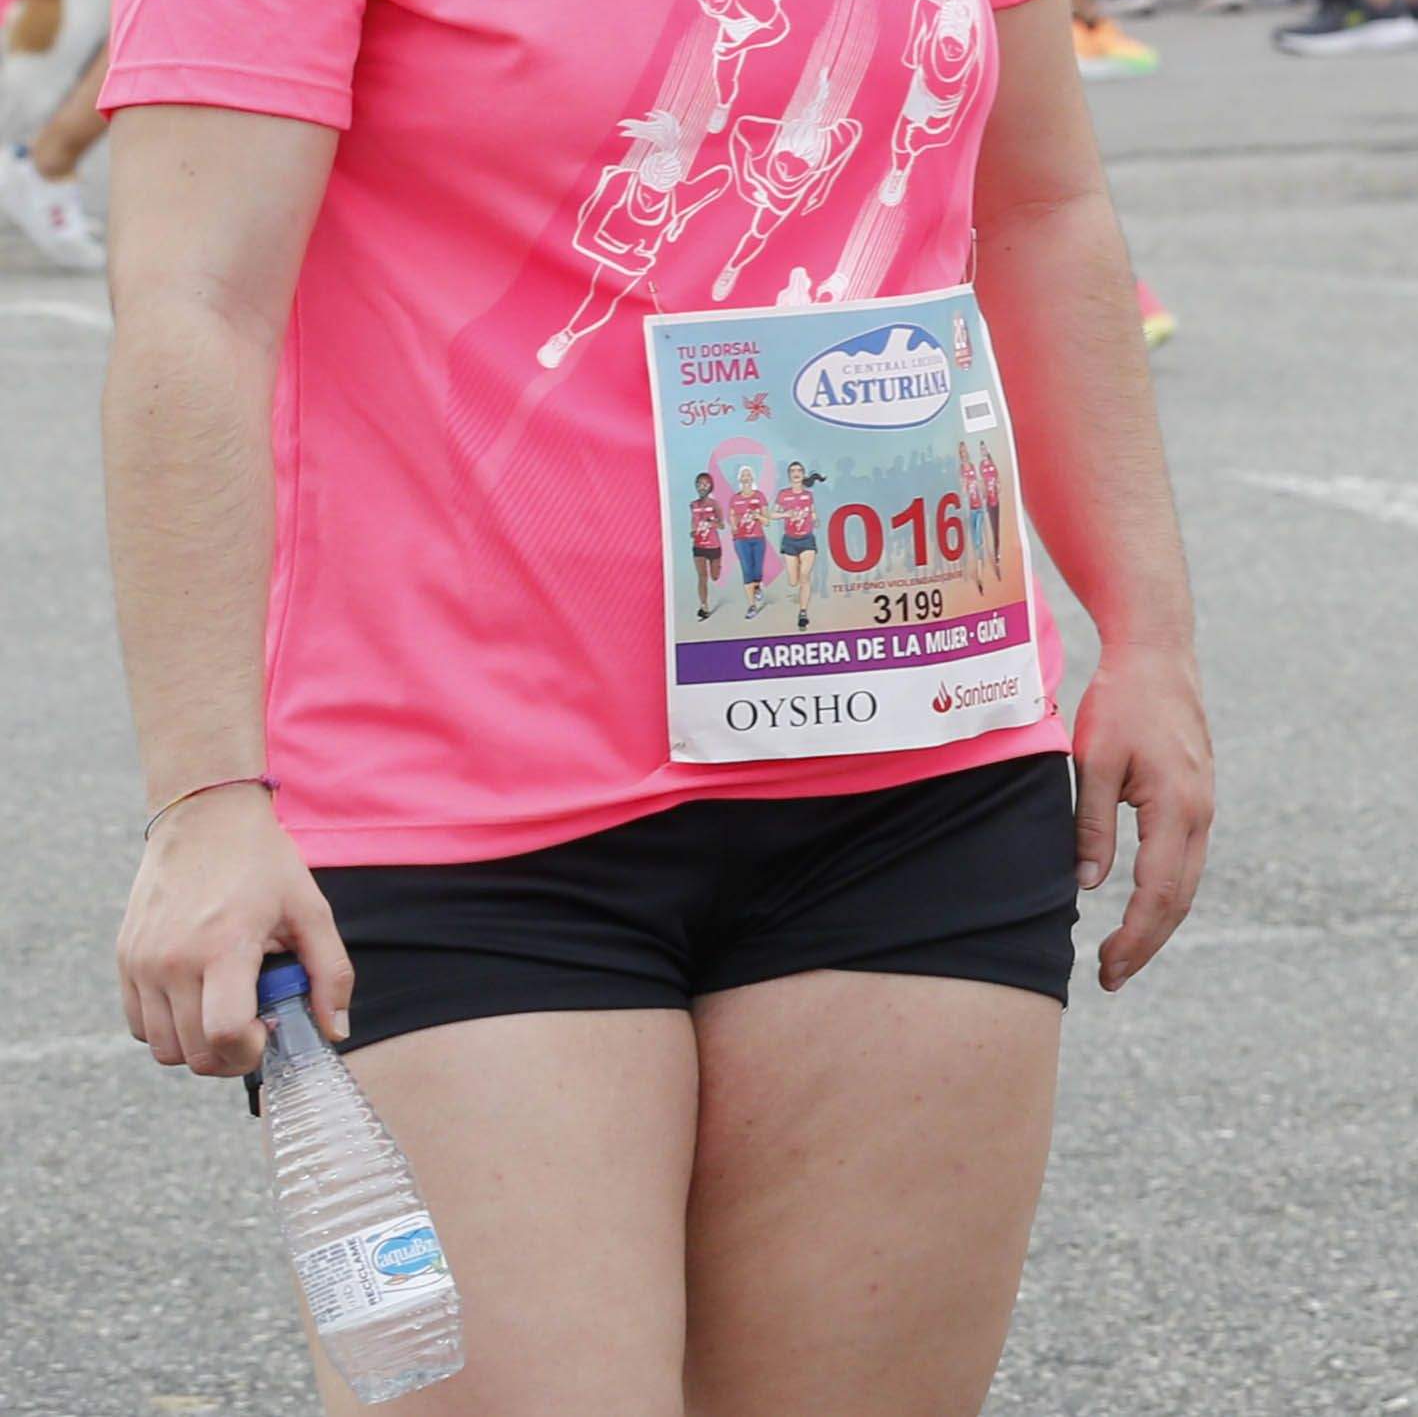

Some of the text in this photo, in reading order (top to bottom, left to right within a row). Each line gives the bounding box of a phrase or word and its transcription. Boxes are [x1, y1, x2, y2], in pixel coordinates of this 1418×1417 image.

[677, 341, 761, 359] TU DORSAL
[842, 359, 908, 375] CENTRAL
[680, 357, 760, 387] SUMA
[810, 368, 949, 408] ASTURIANA
[827, 491, 966, 574] 016
[873, 588, 943, 624] 3199
[743, 635, 851, 670] CARRERA
[856, 636, 886, 661] DE
[892, 634, 922, 658] LA
[925, 626, 969, 655] MUJER
[725, 675, 1020, 732] OYSHO Santander
